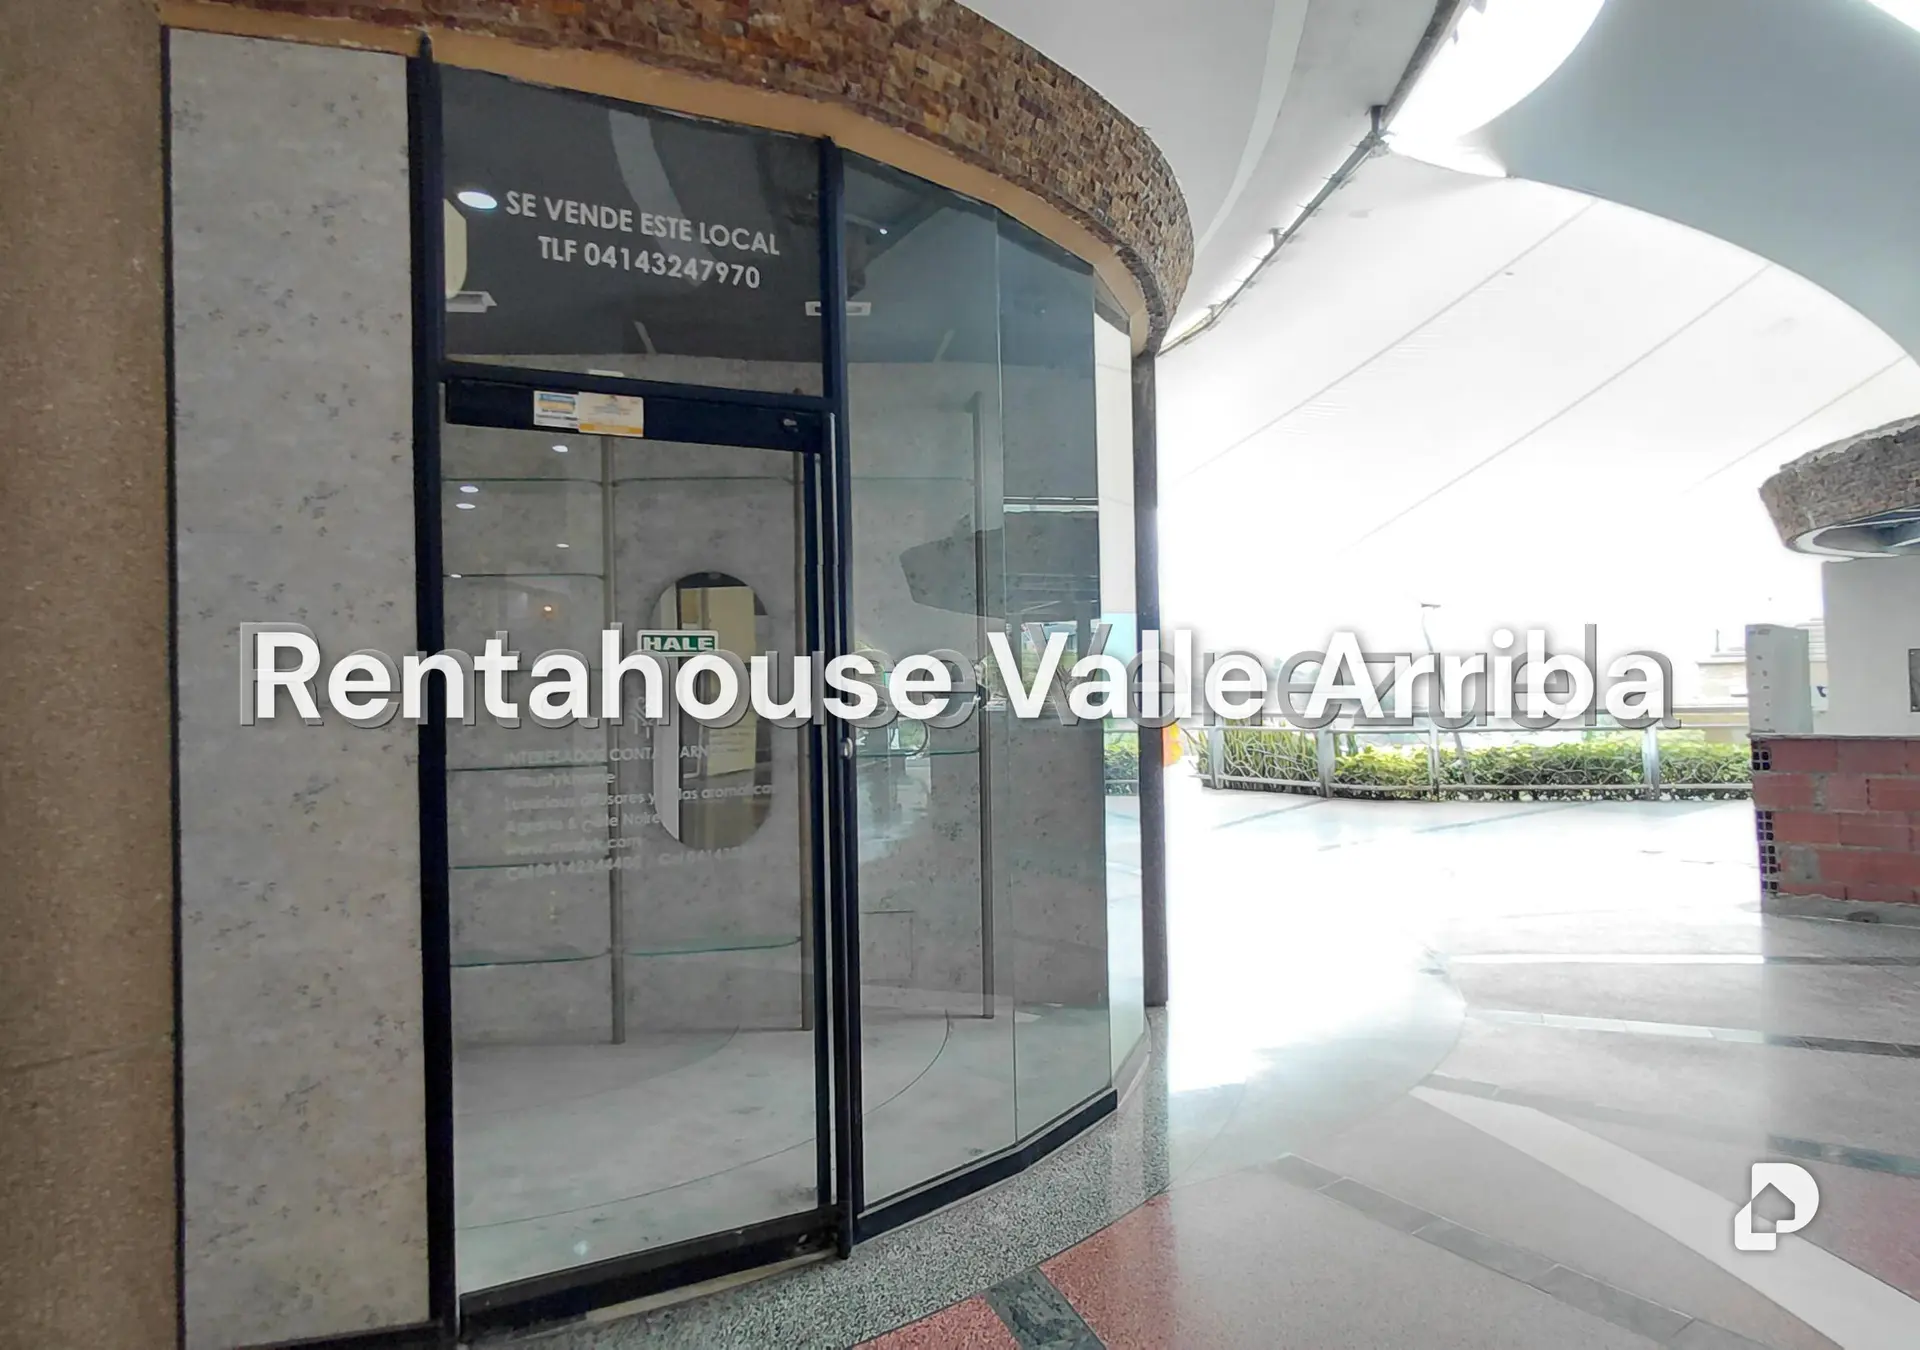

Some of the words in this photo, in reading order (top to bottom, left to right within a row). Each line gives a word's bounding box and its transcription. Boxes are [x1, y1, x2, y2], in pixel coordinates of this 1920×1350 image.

[506, 190, 537, 217] SE
[543, 196, 633, 232] VENDE
[640, 212, 692, 242] ESTE
[699, 221, 780, 256] LOCAL
[538, 235, 577, 262] TLF
[584, 242, 760, 289] 04143247970
[643, 636, 714, 651] HALE
